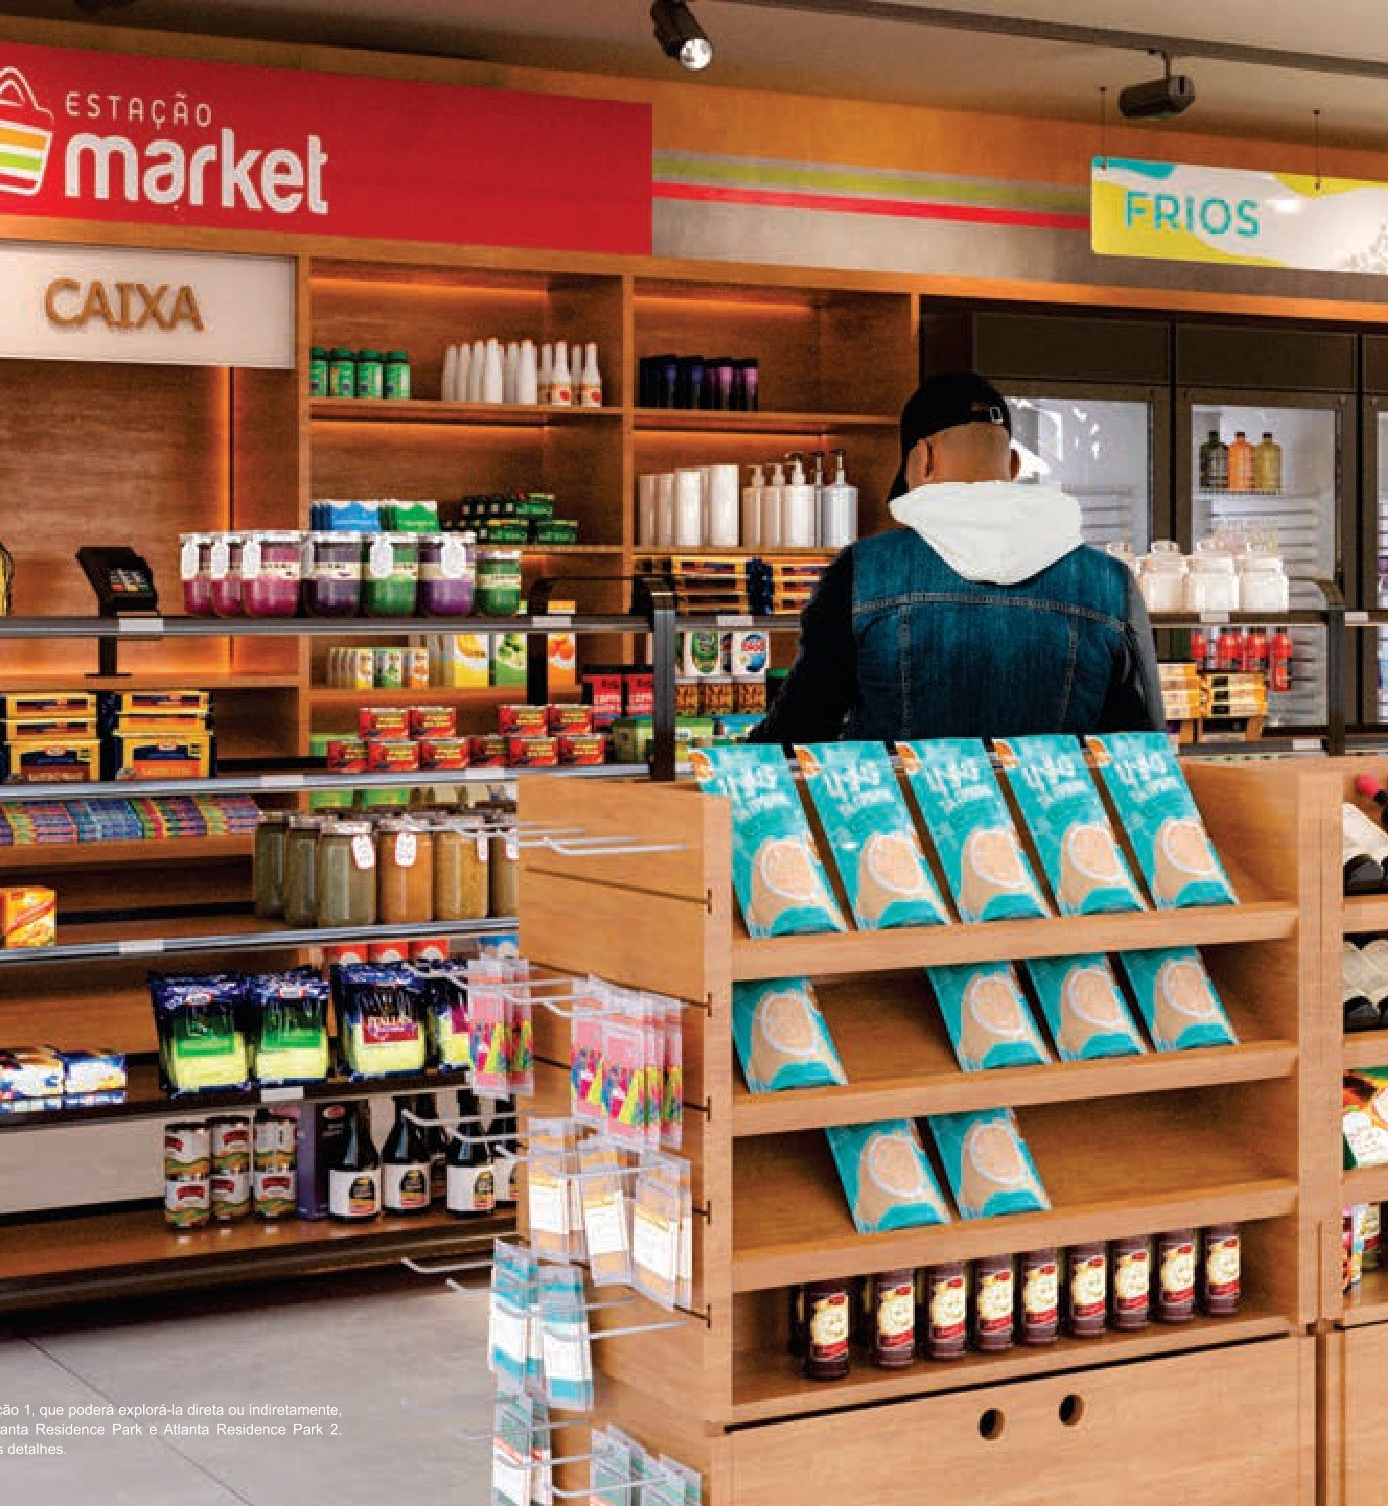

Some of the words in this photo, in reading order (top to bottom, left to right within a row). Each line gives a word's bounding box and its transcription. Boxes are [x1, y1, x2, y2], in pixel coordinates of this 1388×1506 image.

[64, 90, 213, 130] ESTAÇÃO
[64, 127, 329, 215] market
[1125, 190, 1261, 238] FRIOS
[44, 276, 205, 333] CAIXA
